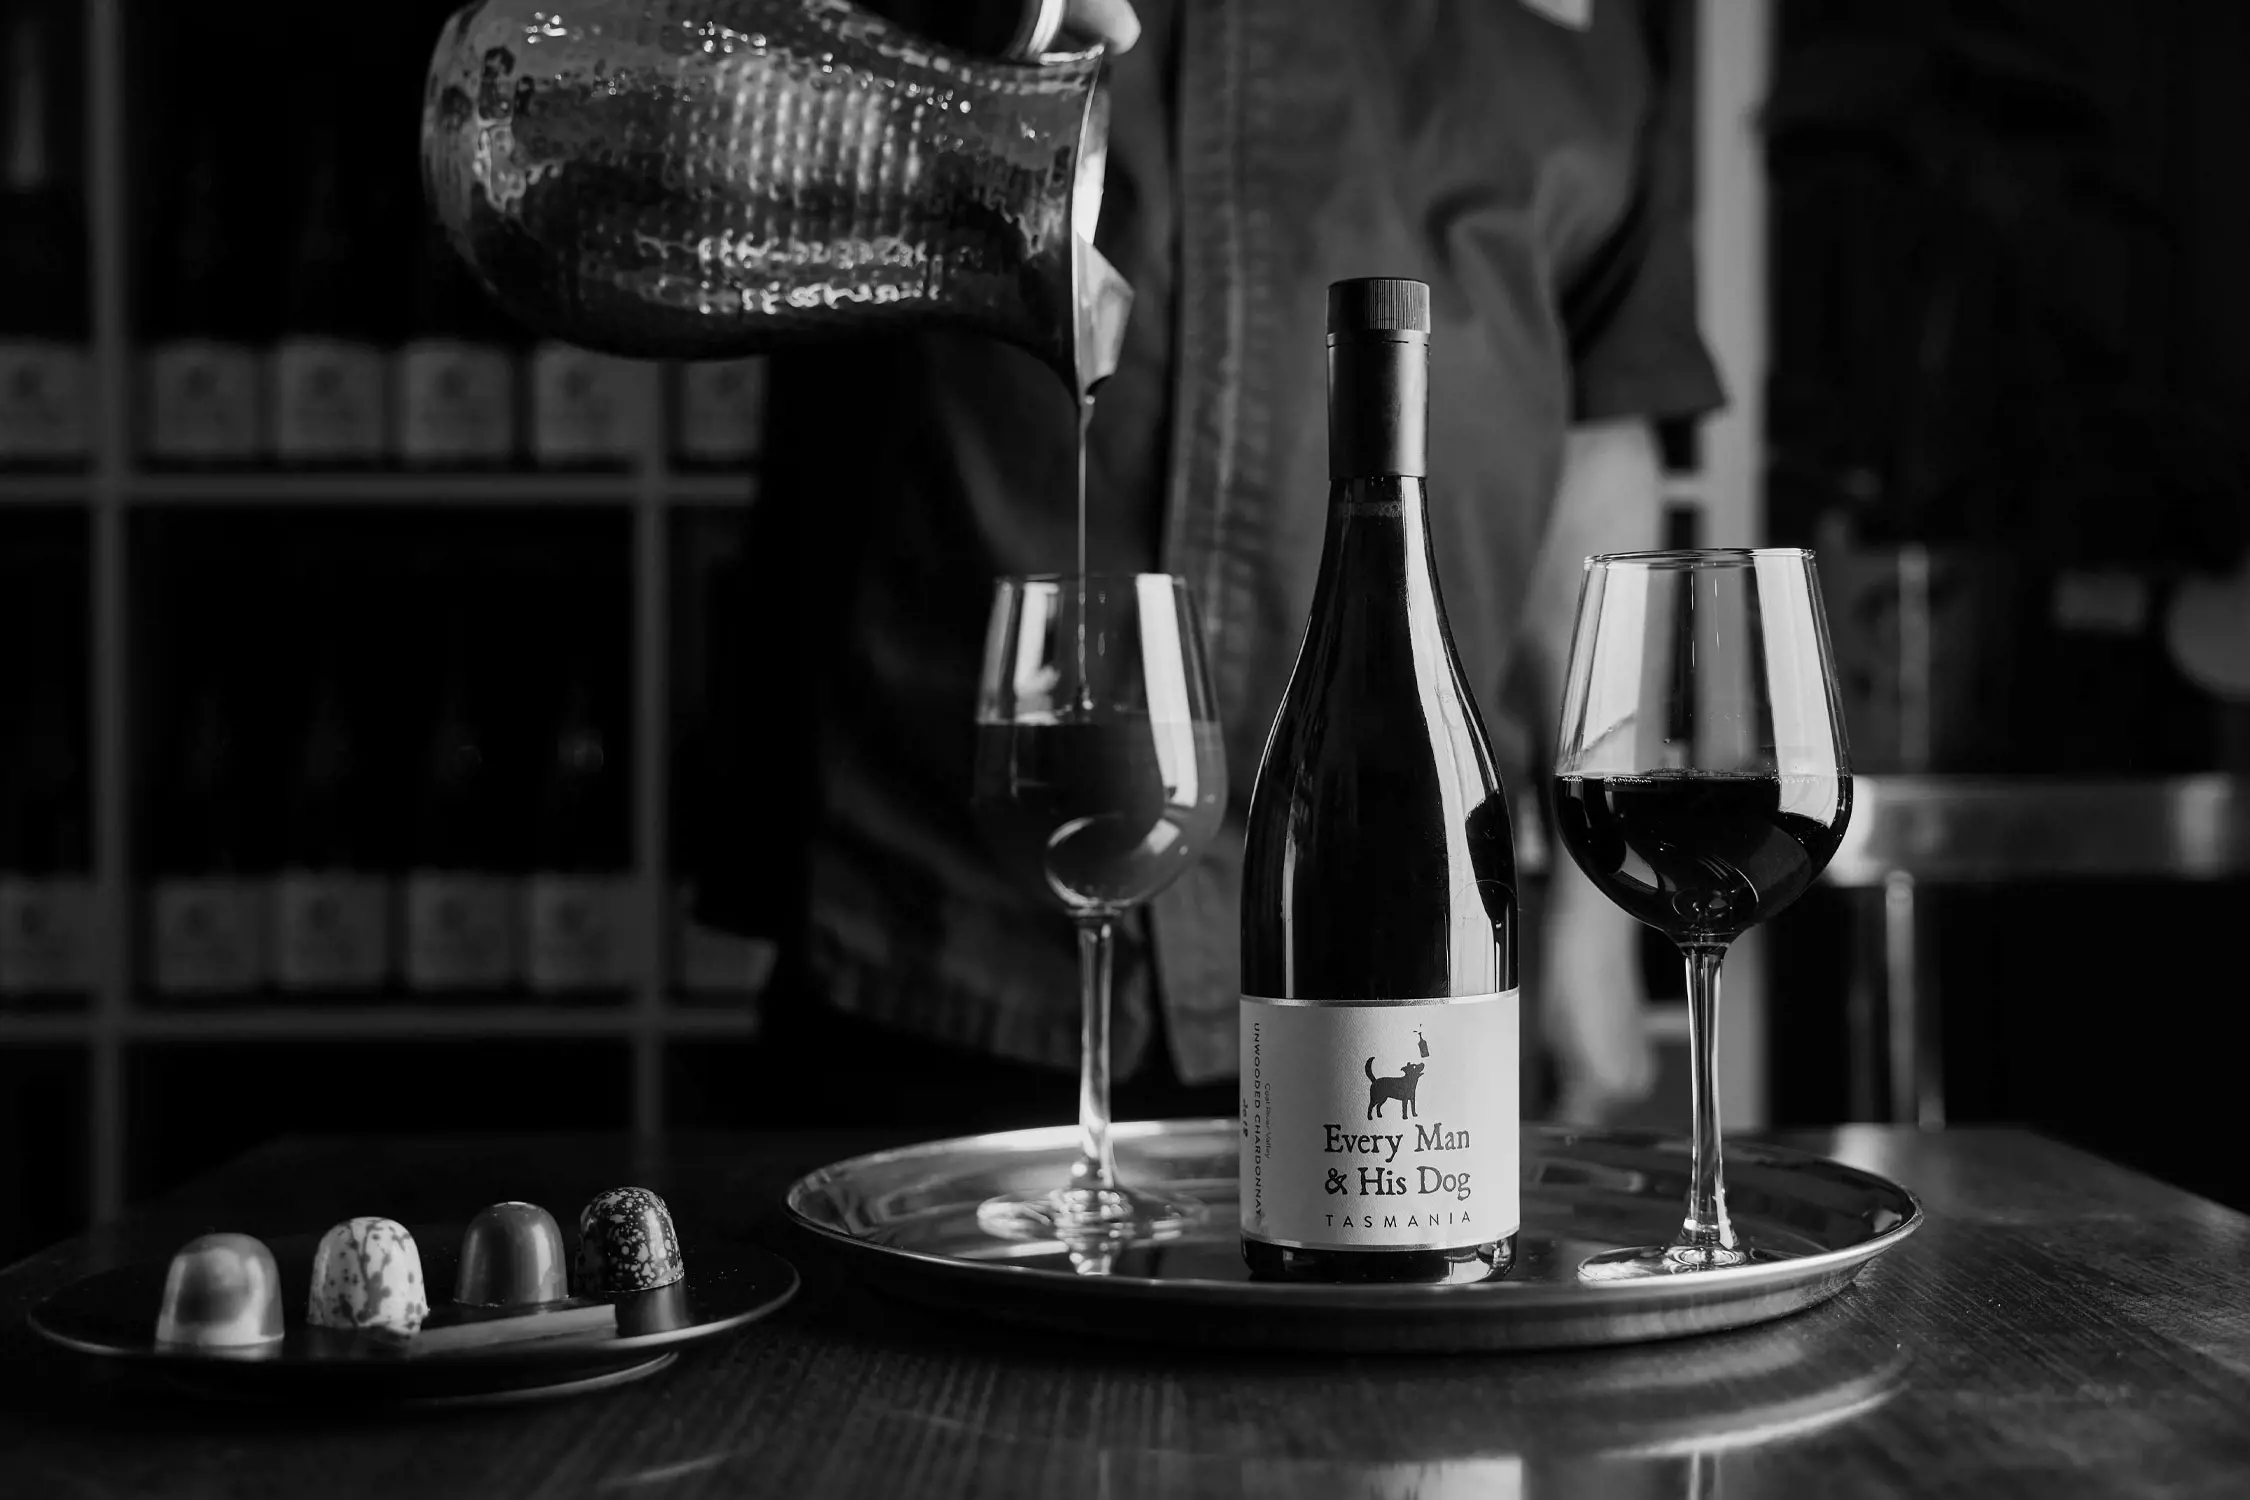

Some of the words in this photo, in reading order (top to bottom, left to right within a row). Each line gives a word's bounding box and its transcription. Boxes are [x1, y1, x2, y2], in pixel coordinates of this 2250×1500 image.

[1253, 1022, 1261, 1110] UNWOODED
[1323, 1124, 1404, 1163] Every
[1414, 1122, 1470, 1153] Man
[1254, 1114, 1263, 1218] CHARDONNAY
[1324, 1168, 1348, 1195] &
[1358, 1167, 1407, 1196] His
[1417, 1166, 1472, 1201] Dog
[1326, 1210, 1471, 1229] TASMANIA
